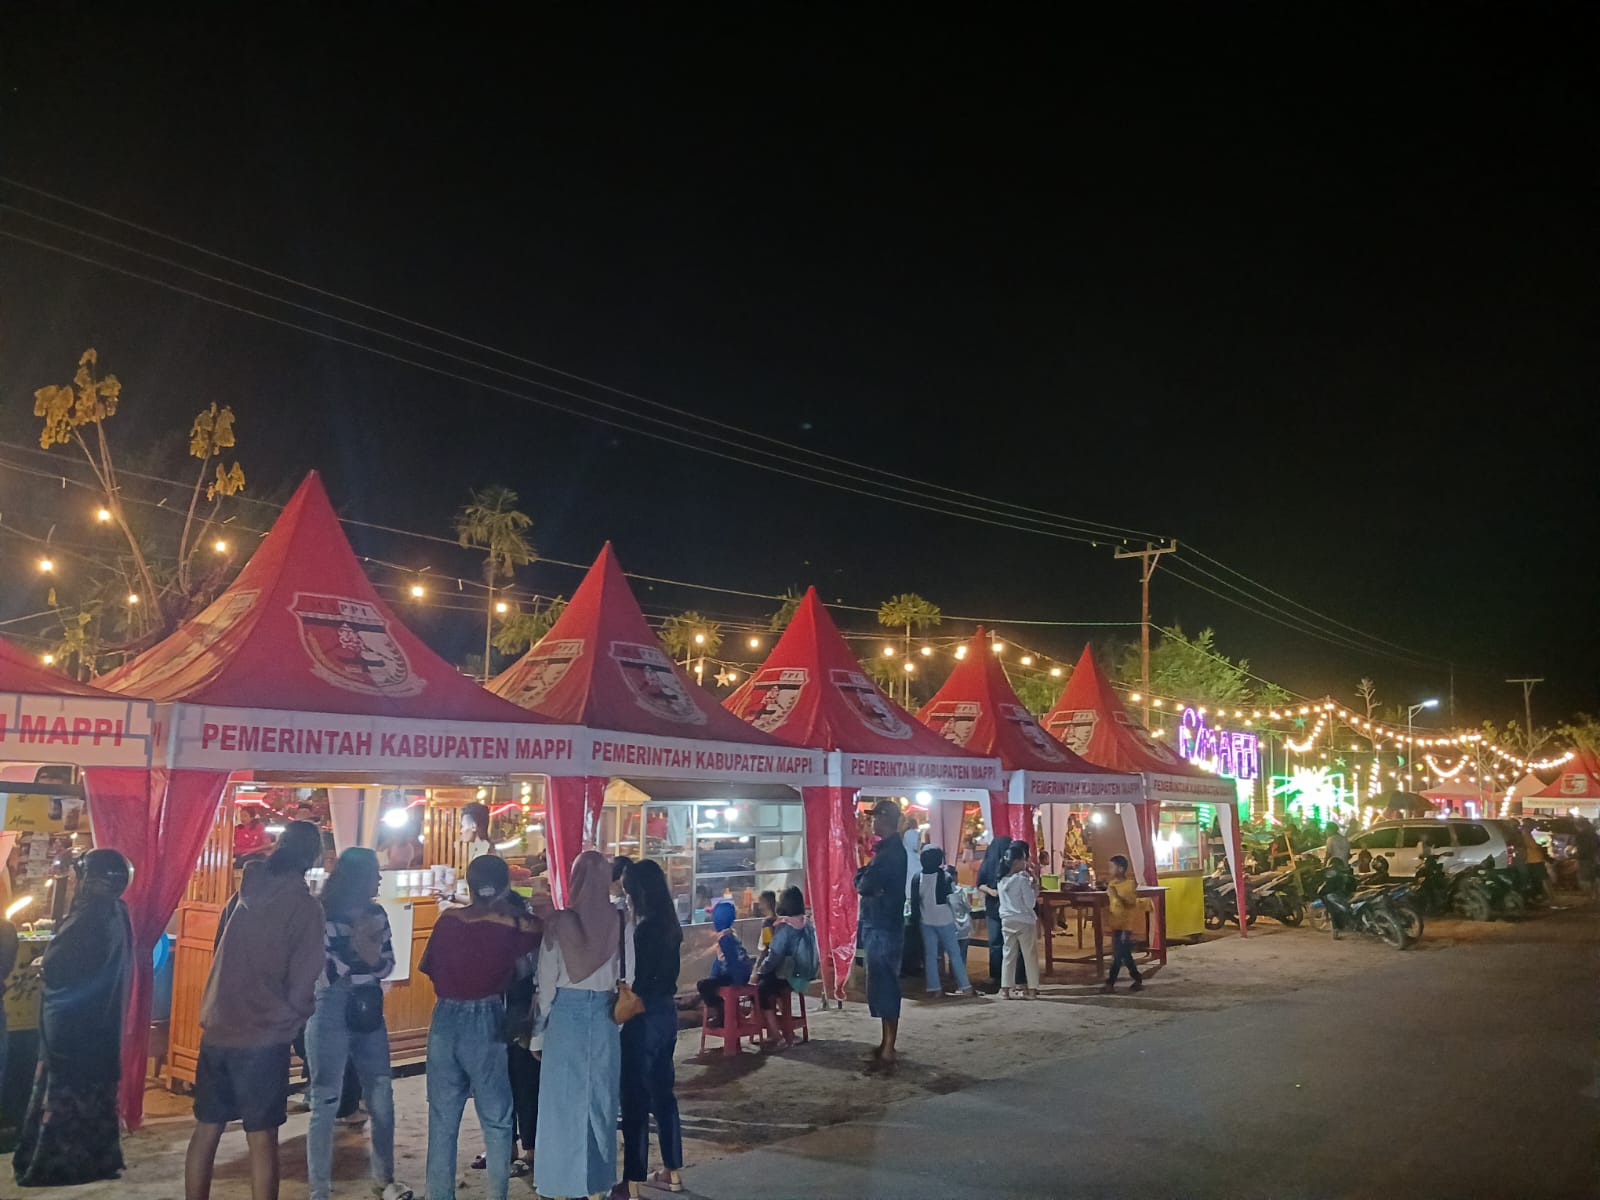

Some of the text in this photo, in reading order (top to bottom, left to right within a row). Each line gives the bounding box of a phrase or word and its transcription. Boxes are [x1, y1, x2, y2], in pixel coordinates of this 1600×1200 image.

[19, 714, 123, 747] MAPPI
[202, 723, 572, 760] PEMERINTAH KABUPATEN MAPPI
[592, 740, 812, 774] PEMERINTAH KABUPATEN MAPPI
[851, 758, 996, 780] PEMERINTAH KABUPATEN MAPPI
